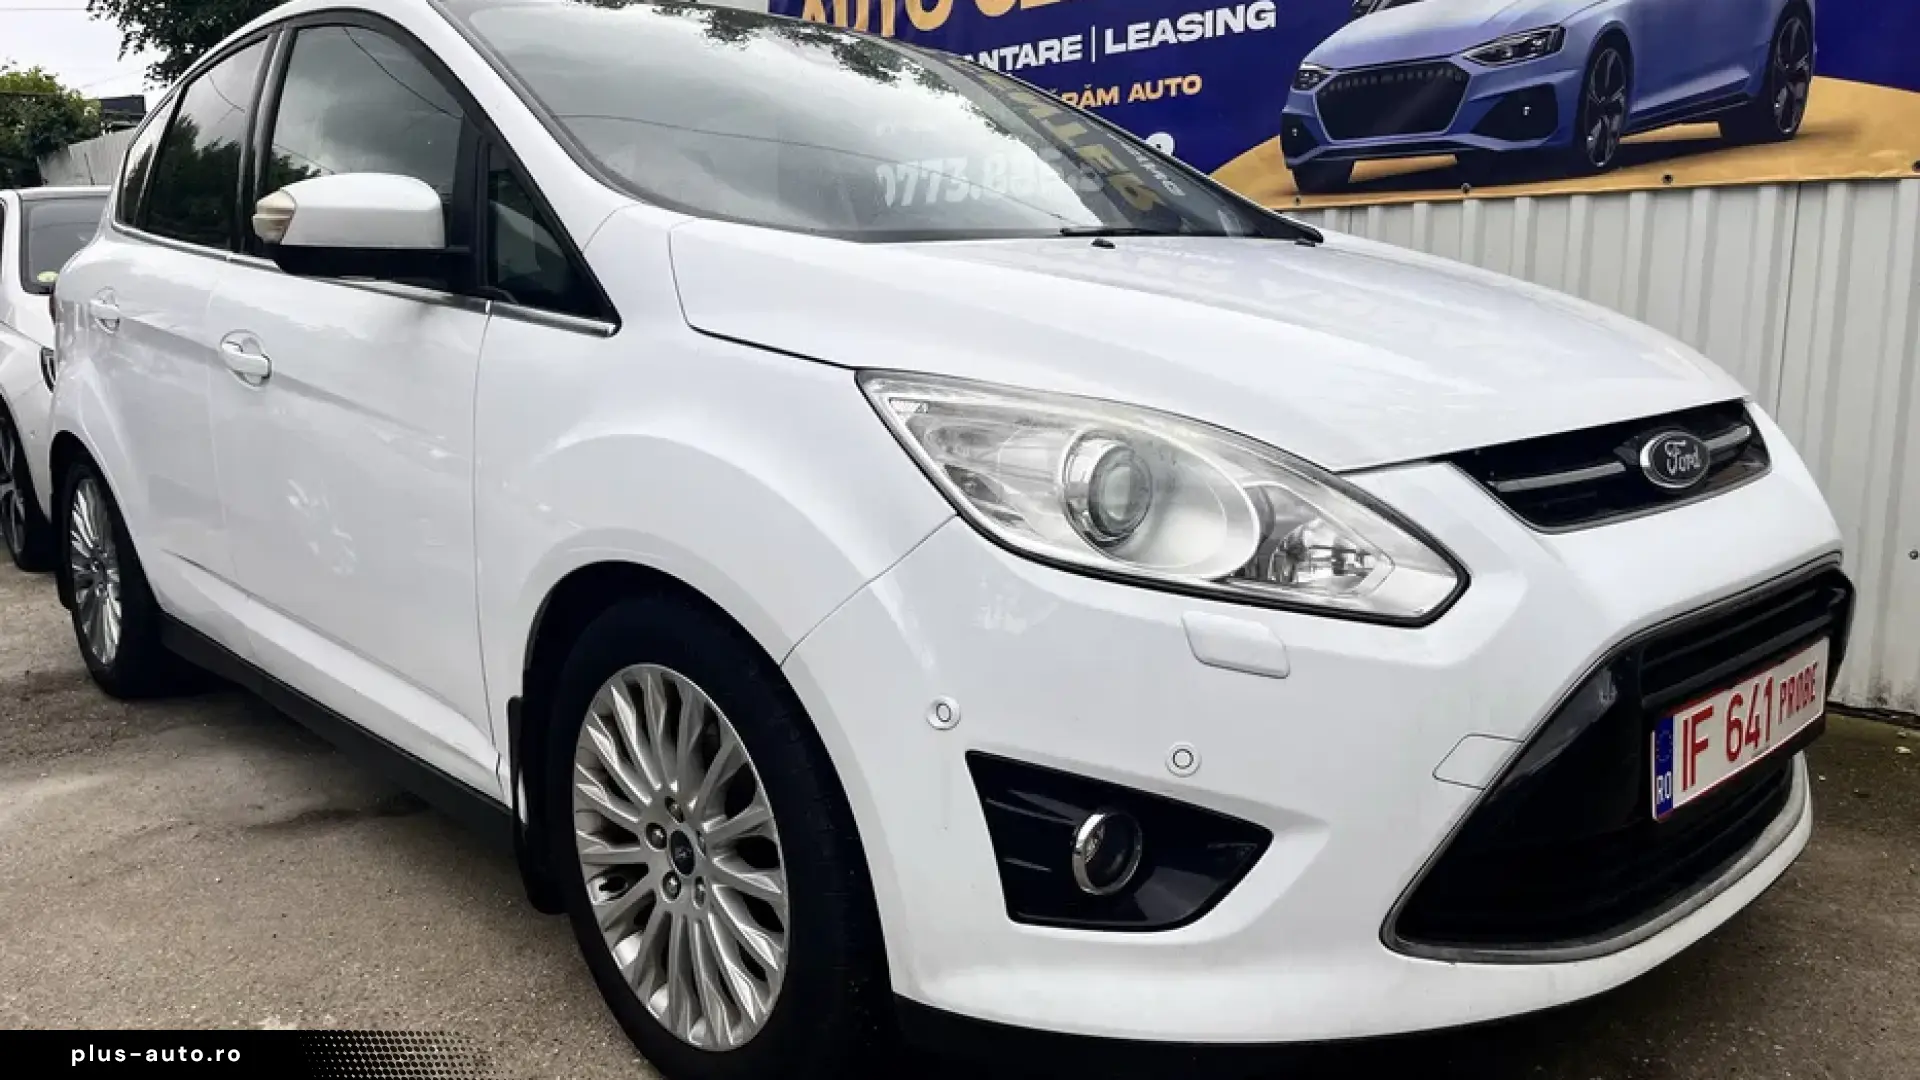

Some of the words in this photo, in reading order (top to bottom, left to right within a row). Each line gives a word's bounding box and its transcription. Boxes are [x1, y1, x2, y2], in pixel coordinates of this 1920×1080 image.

[1104, 0, 1277, 54] LEASING
[1128, 74, 1203, 103] AUTO
[1664, 440, 1701, 475] Ford
[1682, 705, 1714, 792] IF
[1726, 676, 1774, 762] 641
[1778, 661, 1818, 725] PROBE
[1656, 771, 1672, 805] RO
